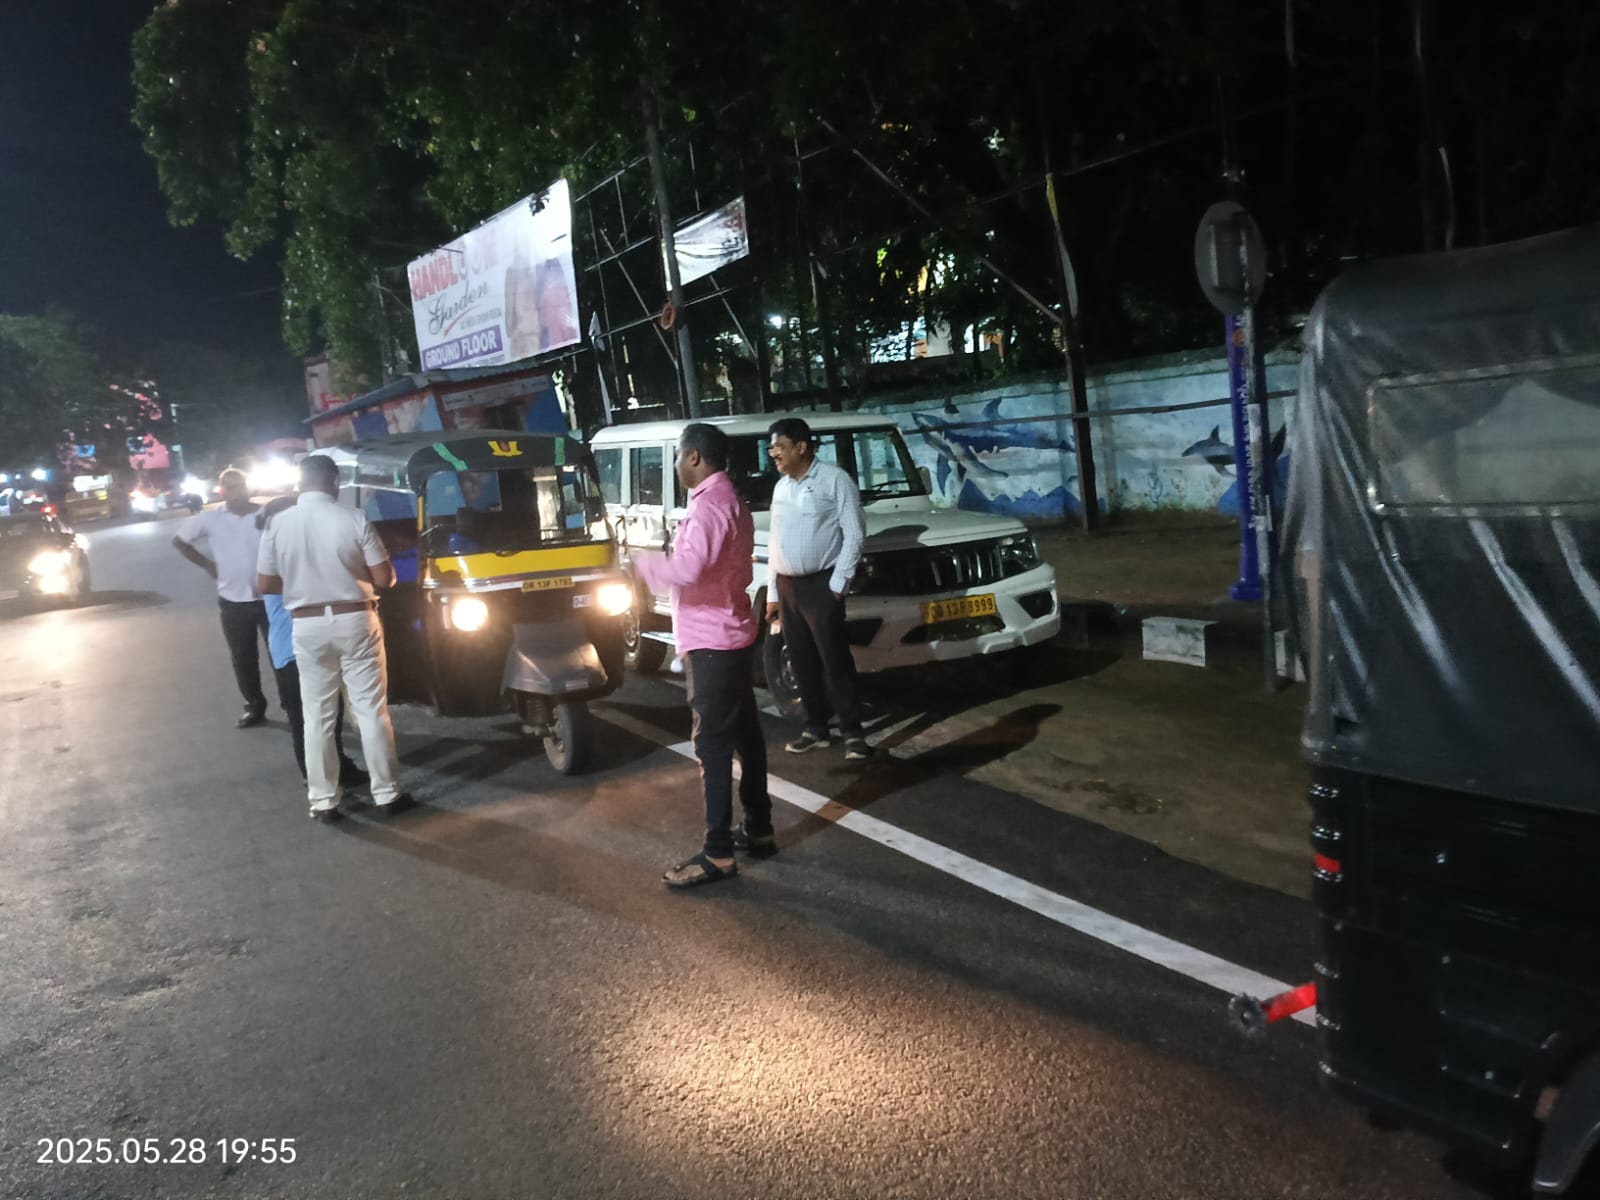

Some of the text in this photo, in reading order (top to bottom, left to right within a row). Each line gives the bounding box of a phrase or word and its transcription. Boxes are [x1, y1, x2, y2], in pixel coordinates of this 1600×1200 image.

[428, 280, 488, 335] Garden
[426, 340, 460, 369] GROUND
[461, 330, 498, 356] FLOOR
